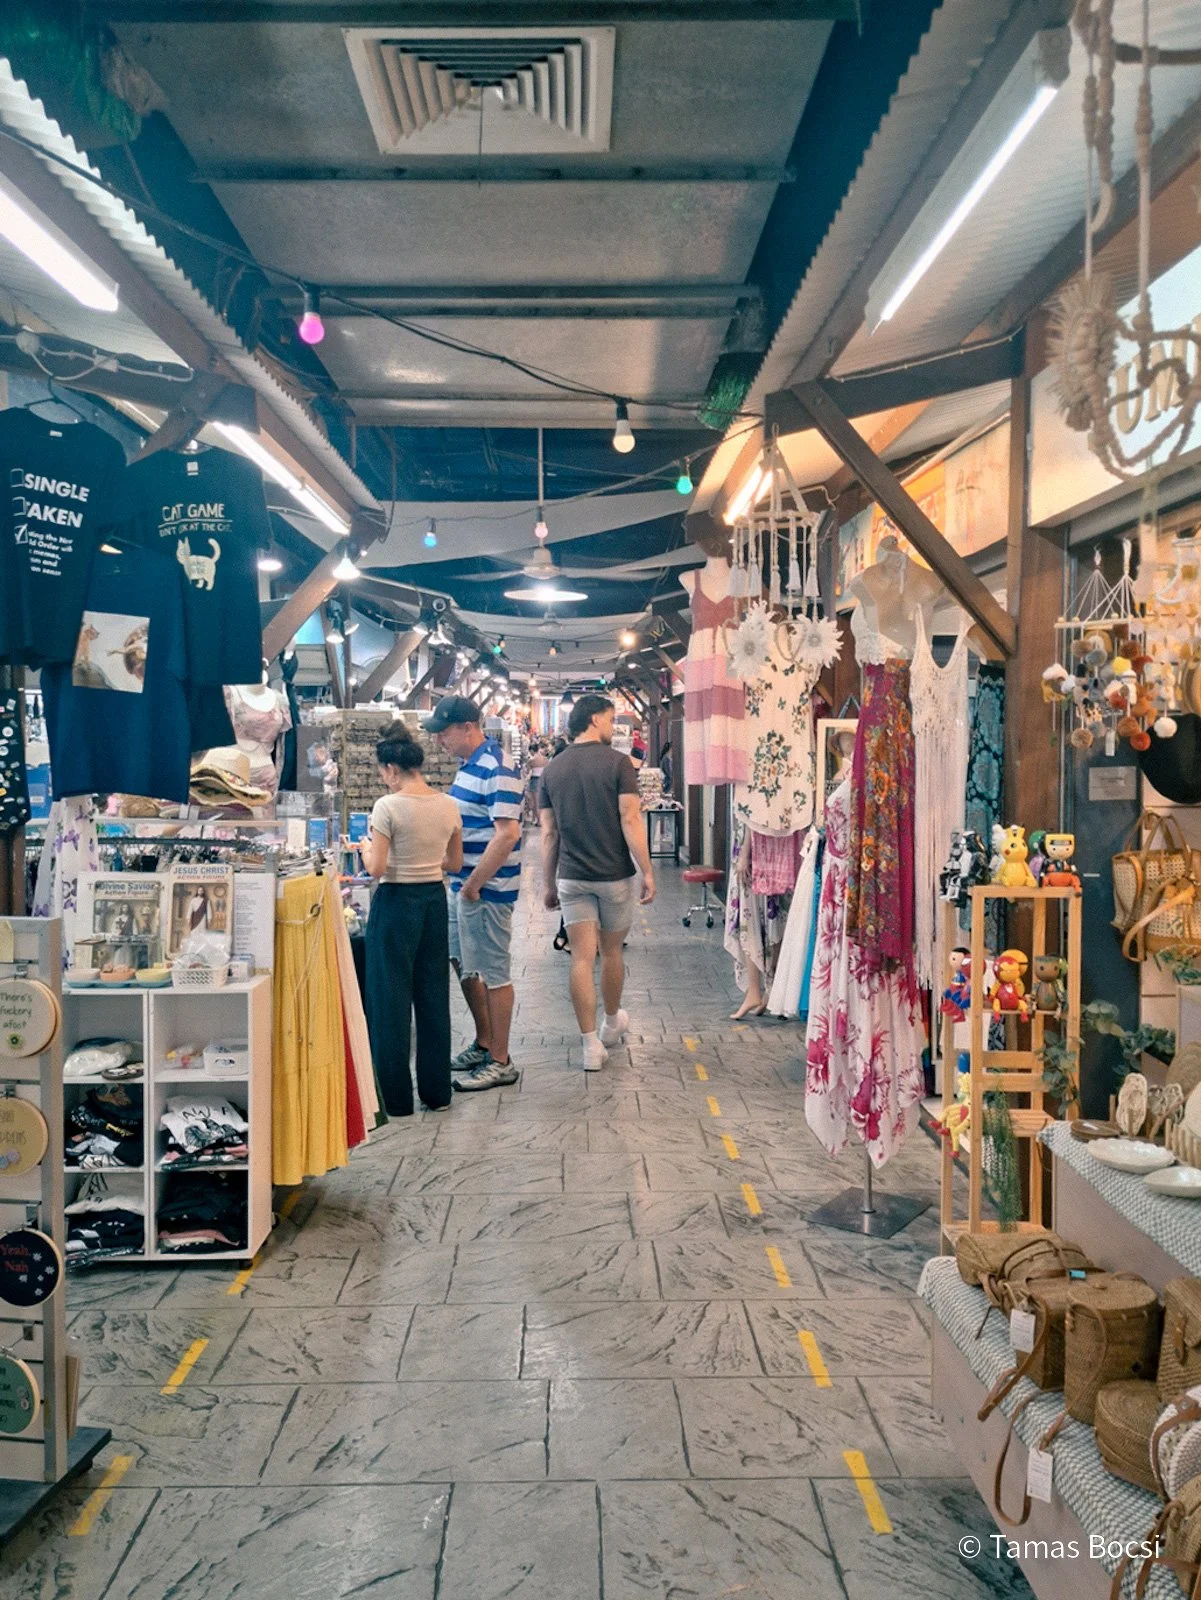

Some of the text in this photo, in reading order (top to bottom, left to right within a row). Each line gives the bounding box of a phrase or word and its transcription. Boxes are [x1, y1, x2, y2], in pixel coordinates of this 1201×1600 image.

[24, 472, 90, 502] SINGLE
[162, 503, 225, 522] CAT GAME
[173, 867, 229, 875] JESUS CHRIST
[99, 882, 125, 891] Divine
